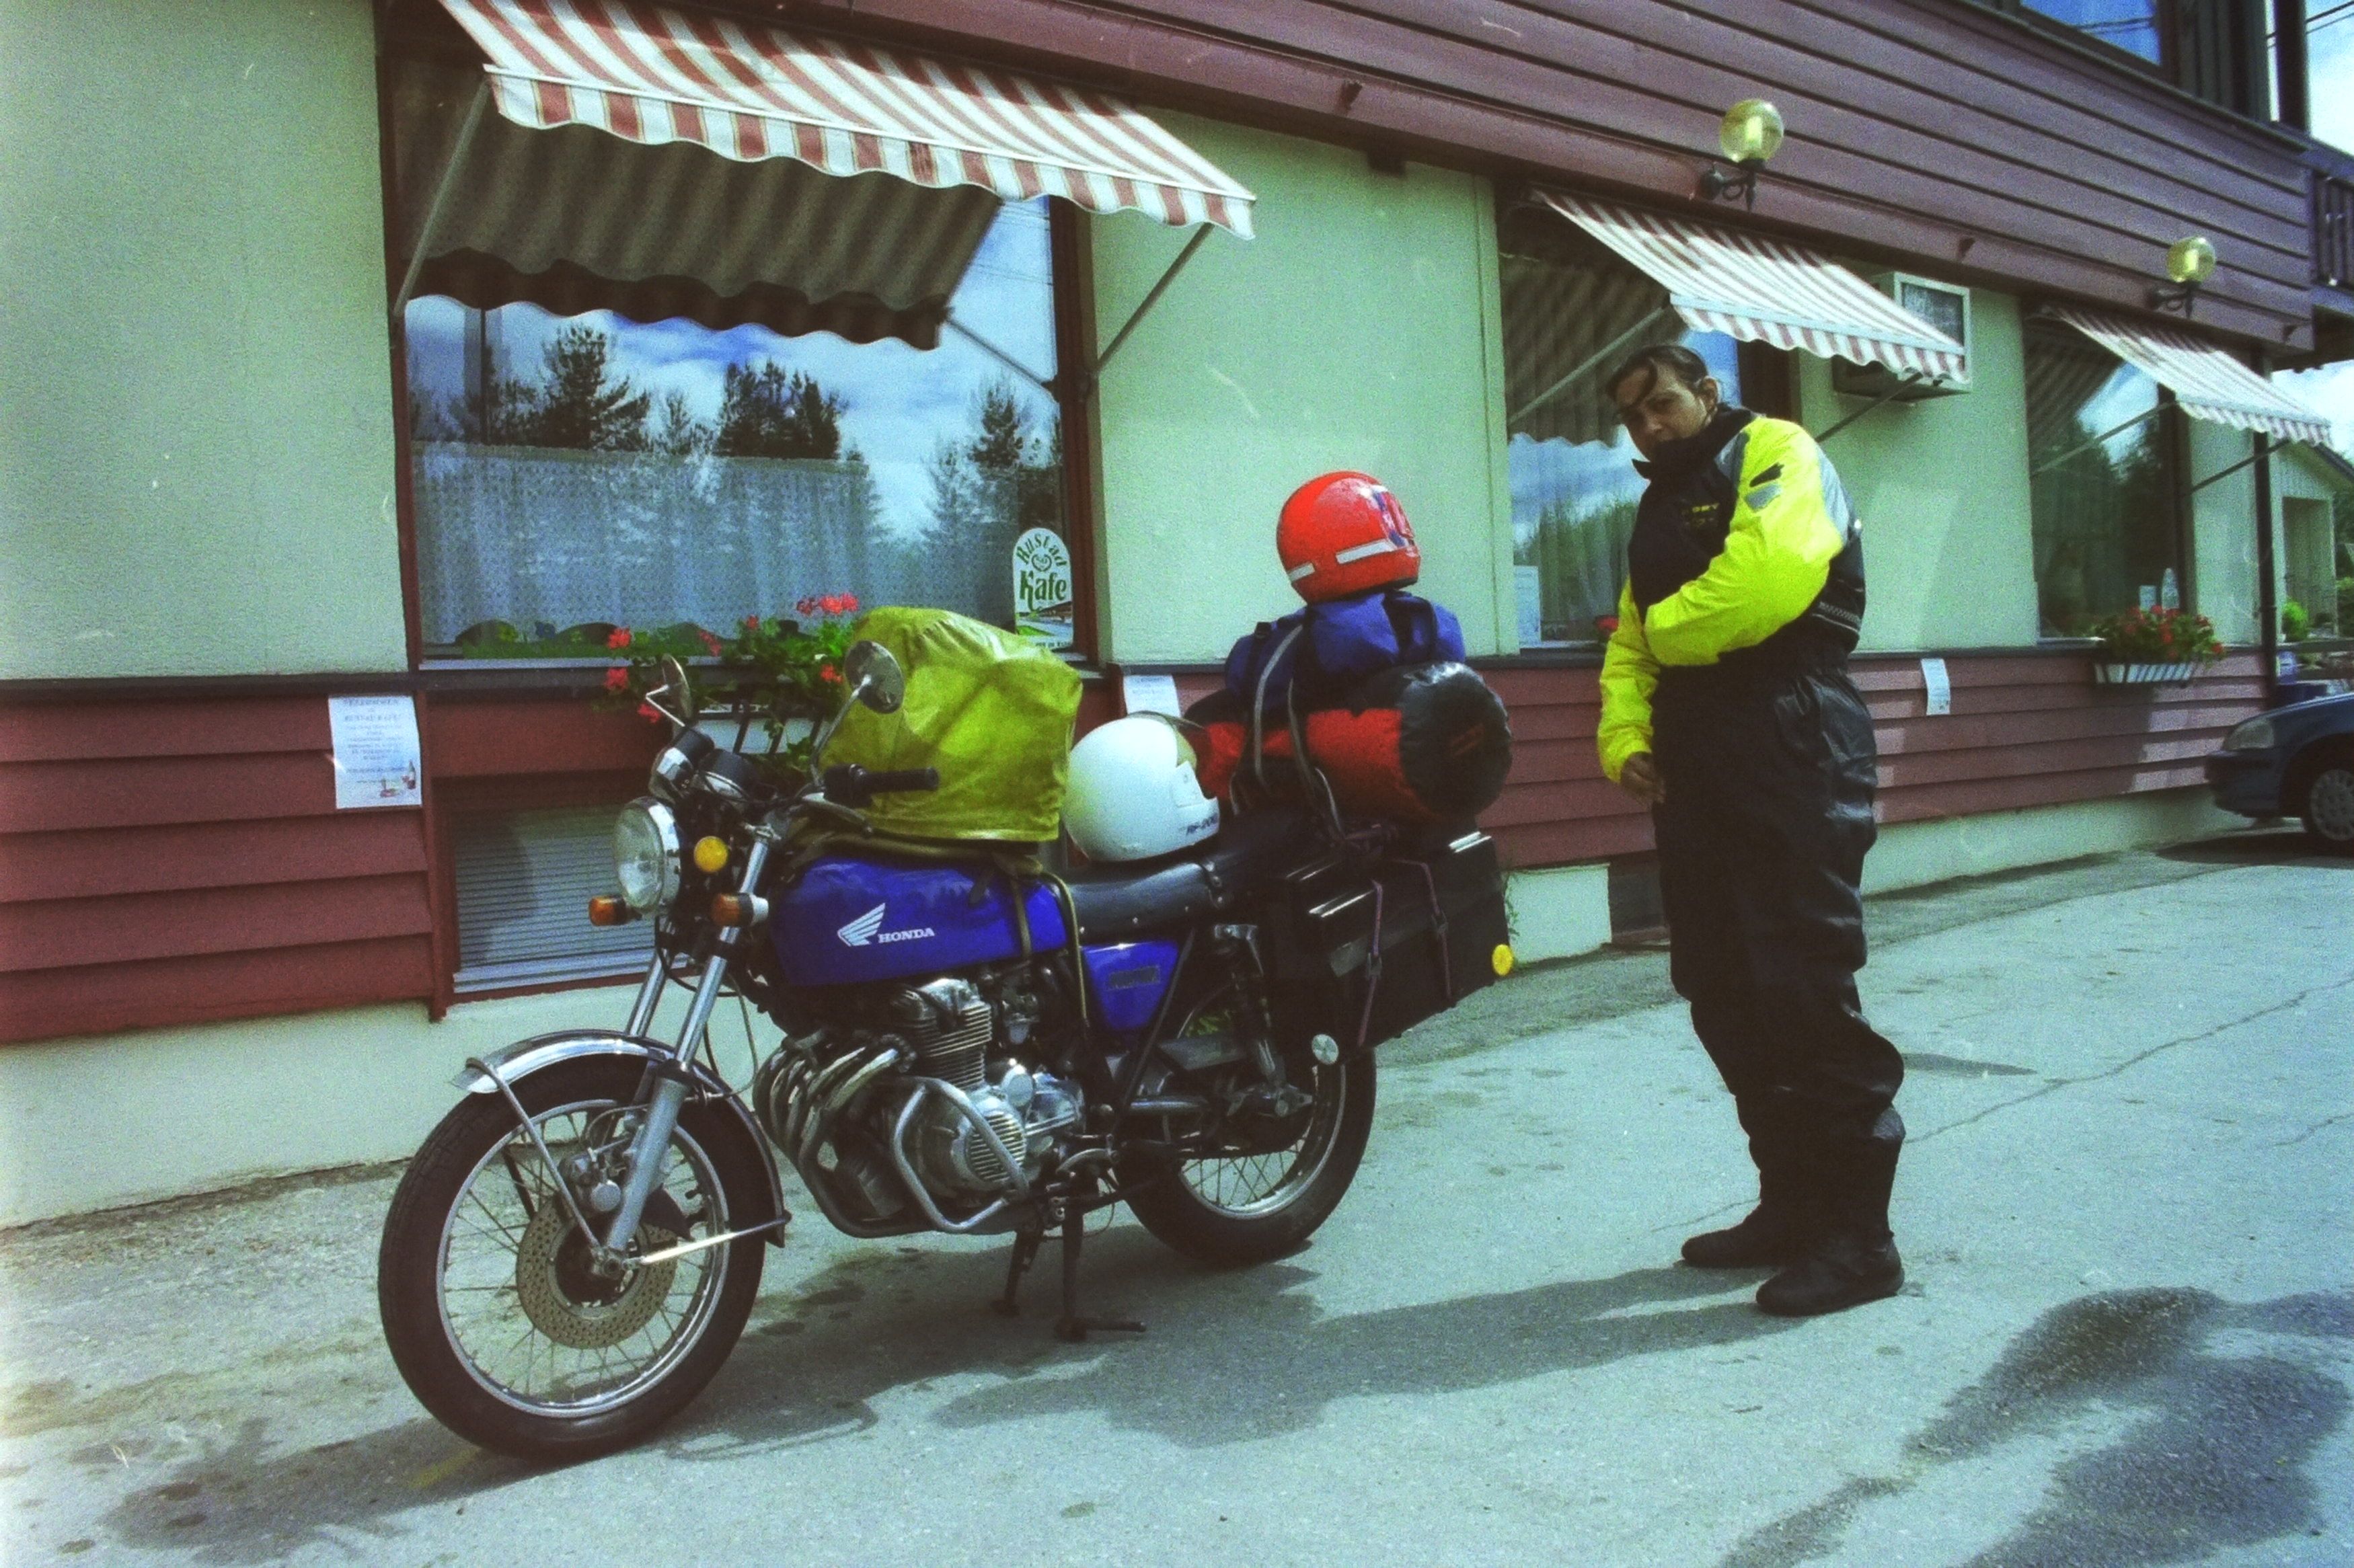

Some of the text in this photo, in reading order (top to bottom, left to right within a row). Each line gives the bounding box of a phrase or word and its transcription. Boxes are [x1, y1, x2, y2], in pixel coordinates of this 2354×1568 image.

[1016, 533, 1067, 567] Rustad
[1020, 570, 1067, 612] Kafe
[878, 928, 935, 943] HONDA
